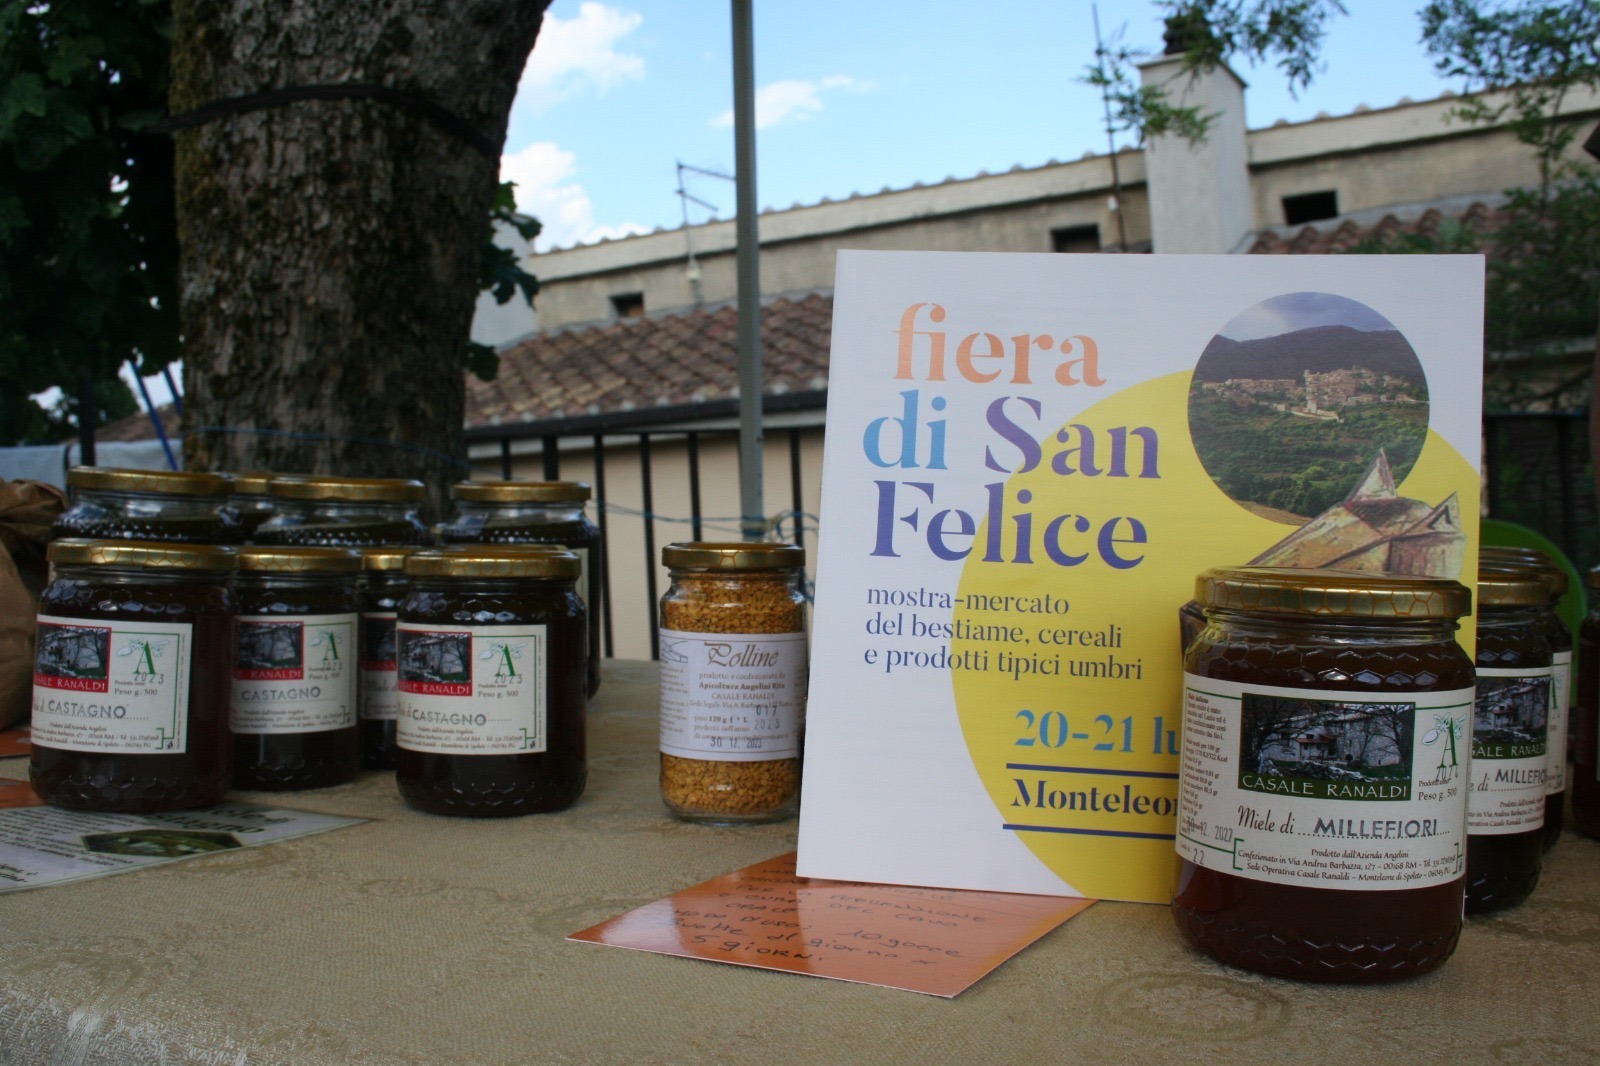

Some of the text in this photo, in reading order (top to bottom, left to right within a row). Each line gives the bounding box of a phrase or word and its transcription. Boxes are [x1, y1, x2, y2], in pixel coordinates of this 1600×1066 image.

[893, 303, 1107, 387] fiera
[863, 389, 1161, 479] di San
[869, 480, 1148, 570] Felice
[867, 587, 1070, 615] mostra-mercato
[866, 612, 1122, 648] del bestiame, cereali
[704, 640, 779, 668] Polline
[864, 645, 1143, 681] e prodotti tipici umbri
[58, 679, 105, 691] RANALDI
[251, 670, 302, 680] RANALDI
[144, 688, 158, 697] 500
[242, 686, 321, 701] CASTAGNO
[422, 684, 469, 695] RANALDI
[699, 682, 738, 690] Apicoltura
[740, 683, 771, 691] Angelini
[711, 692, 775, 700] CASALE RANALDI
[48, 700, 127, 719] CASTAGNO
[412, 709, 487, 727] CASTAGNO
[1015, 709, 1135, 753] 20-21
[1242, 775, 1407, 799] CASALE RANALDI
[1477, 772, 1490, 792] di
[1418, 790, 1437, 801] Peso
[1238, 805, 1438, 839] Miele di MILLEFIORI
[1215, 825, 1234, 843] 2027
[1238, 849, 1278, 862] Confezionato
[1279, 856, 1287, 864] in
[1288, 857, 1301, 866] Via
[1302, 858, 1328, 869] Andrea
[1329, 861, 1363, 871] Barbazza,
[1405, 861, 1417, 870] RM
[1311, 848, 1410, 862] Prodotto dall'Azienda Angelini
[1247, 861, 1261, 871] Sede
[1261, 865, 1296, 876] Operativa
[1296, 869, 1320, 879] Casale
[1321, 872, 1350, 881] Ranaldi
[1358, 873, 1395, 881] Monteleone
[1396, 872, 1403, 881] di
[1403, 870, 1423, 883] Spoleto
